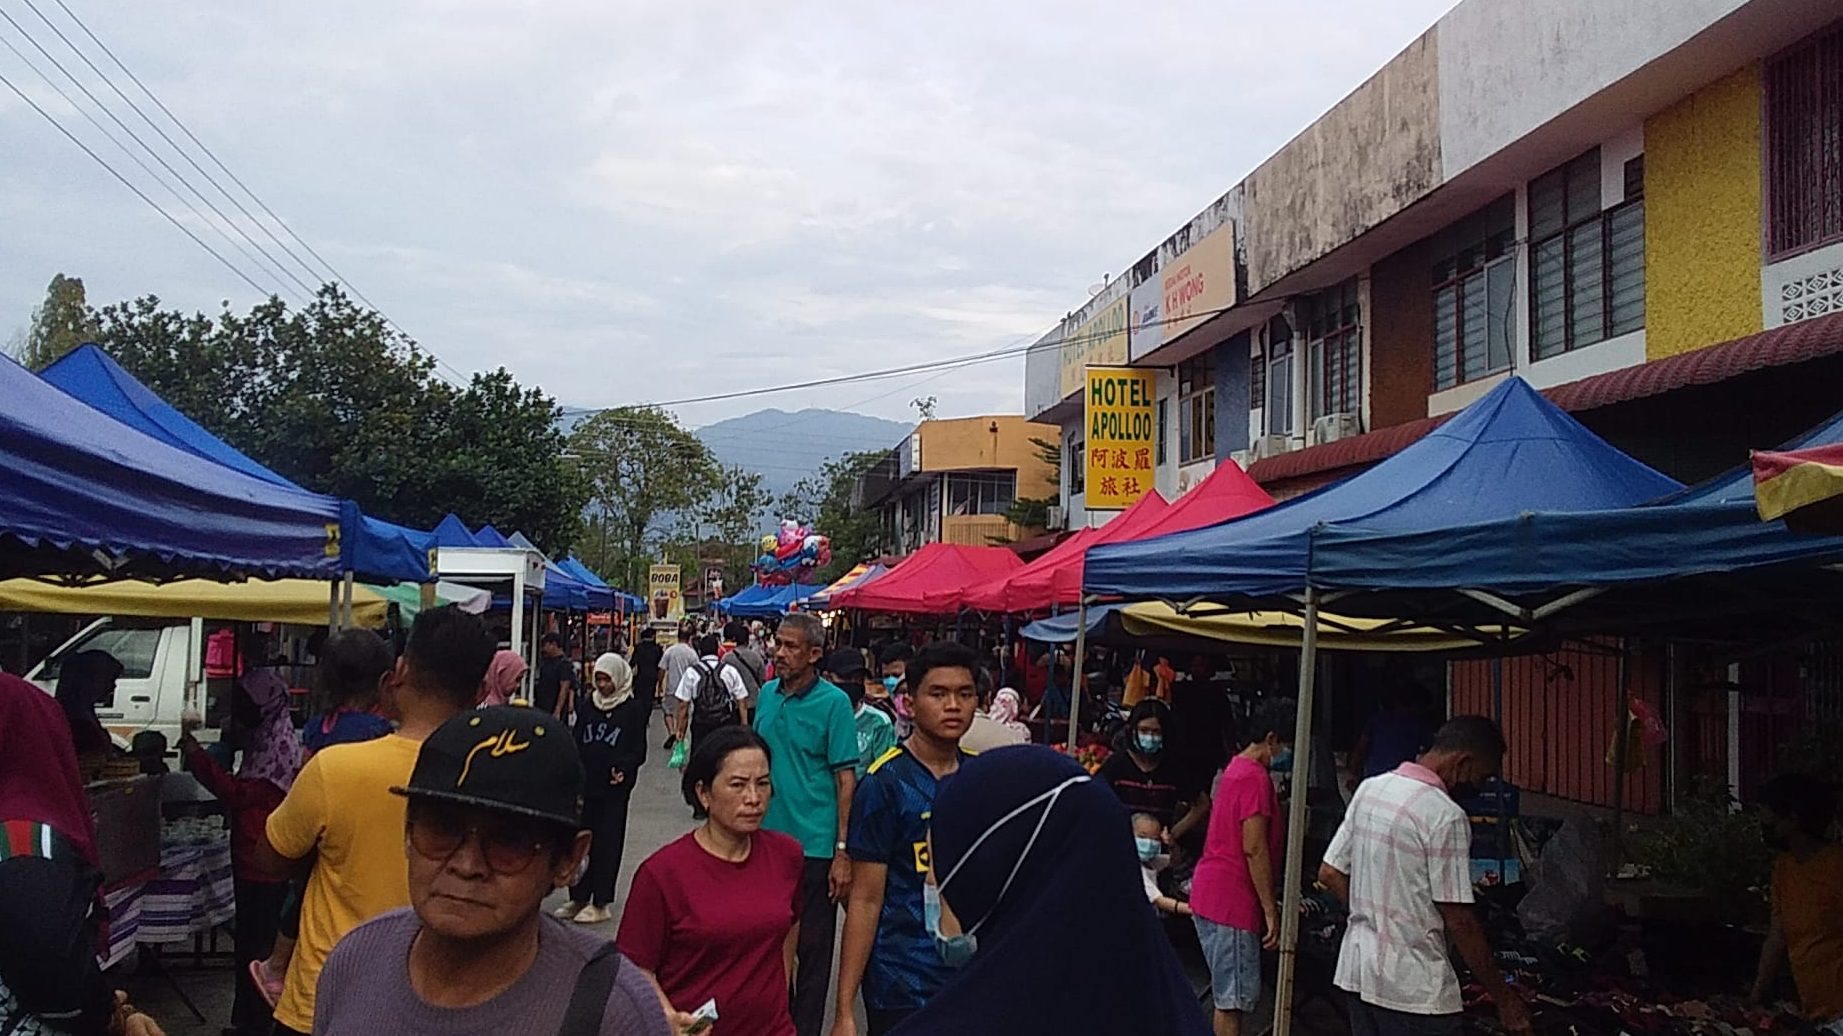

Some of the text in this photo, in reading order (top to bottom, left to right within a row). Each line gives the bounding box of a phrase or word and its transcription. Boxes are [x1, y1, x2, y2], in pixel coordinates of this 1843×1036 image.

[1091, 378, 1151, 407] HOTEL
[1091, 412, 1151, 441] APOLLOO
[1091, 448, 1151, 470] 阿波羅
[1099, 477, 1141, 496] 旅社
[650, 573, 679, 584] BOBA
[583, 722, 621, 747] USA
[457, 728, 530, 787] سلام
